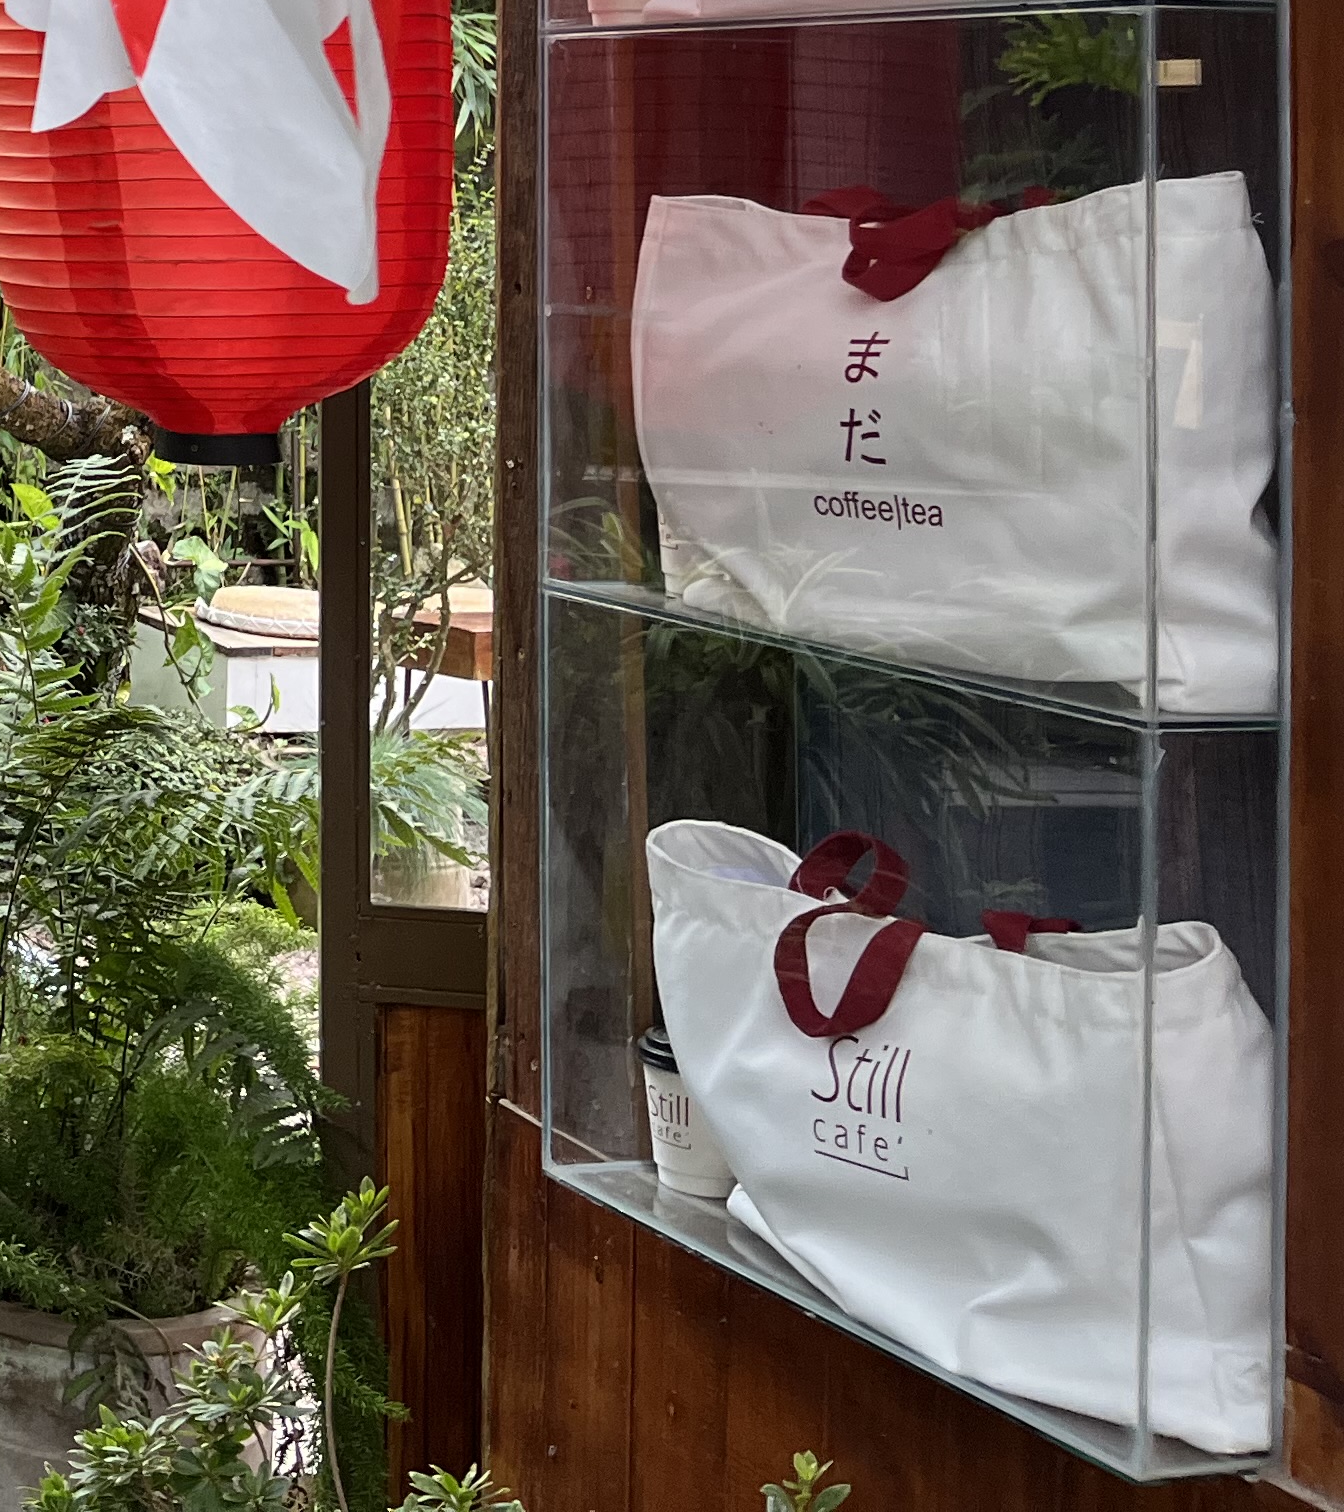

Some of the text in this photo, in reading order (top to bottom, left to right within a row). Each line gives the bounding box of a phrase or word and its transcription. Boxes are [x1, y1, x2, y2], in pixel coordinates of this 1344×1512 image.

[839, 331, 891, 466] まだ
[648, 1084, 690, 1128] Still
[811, 1034, 912, 1123] Still
